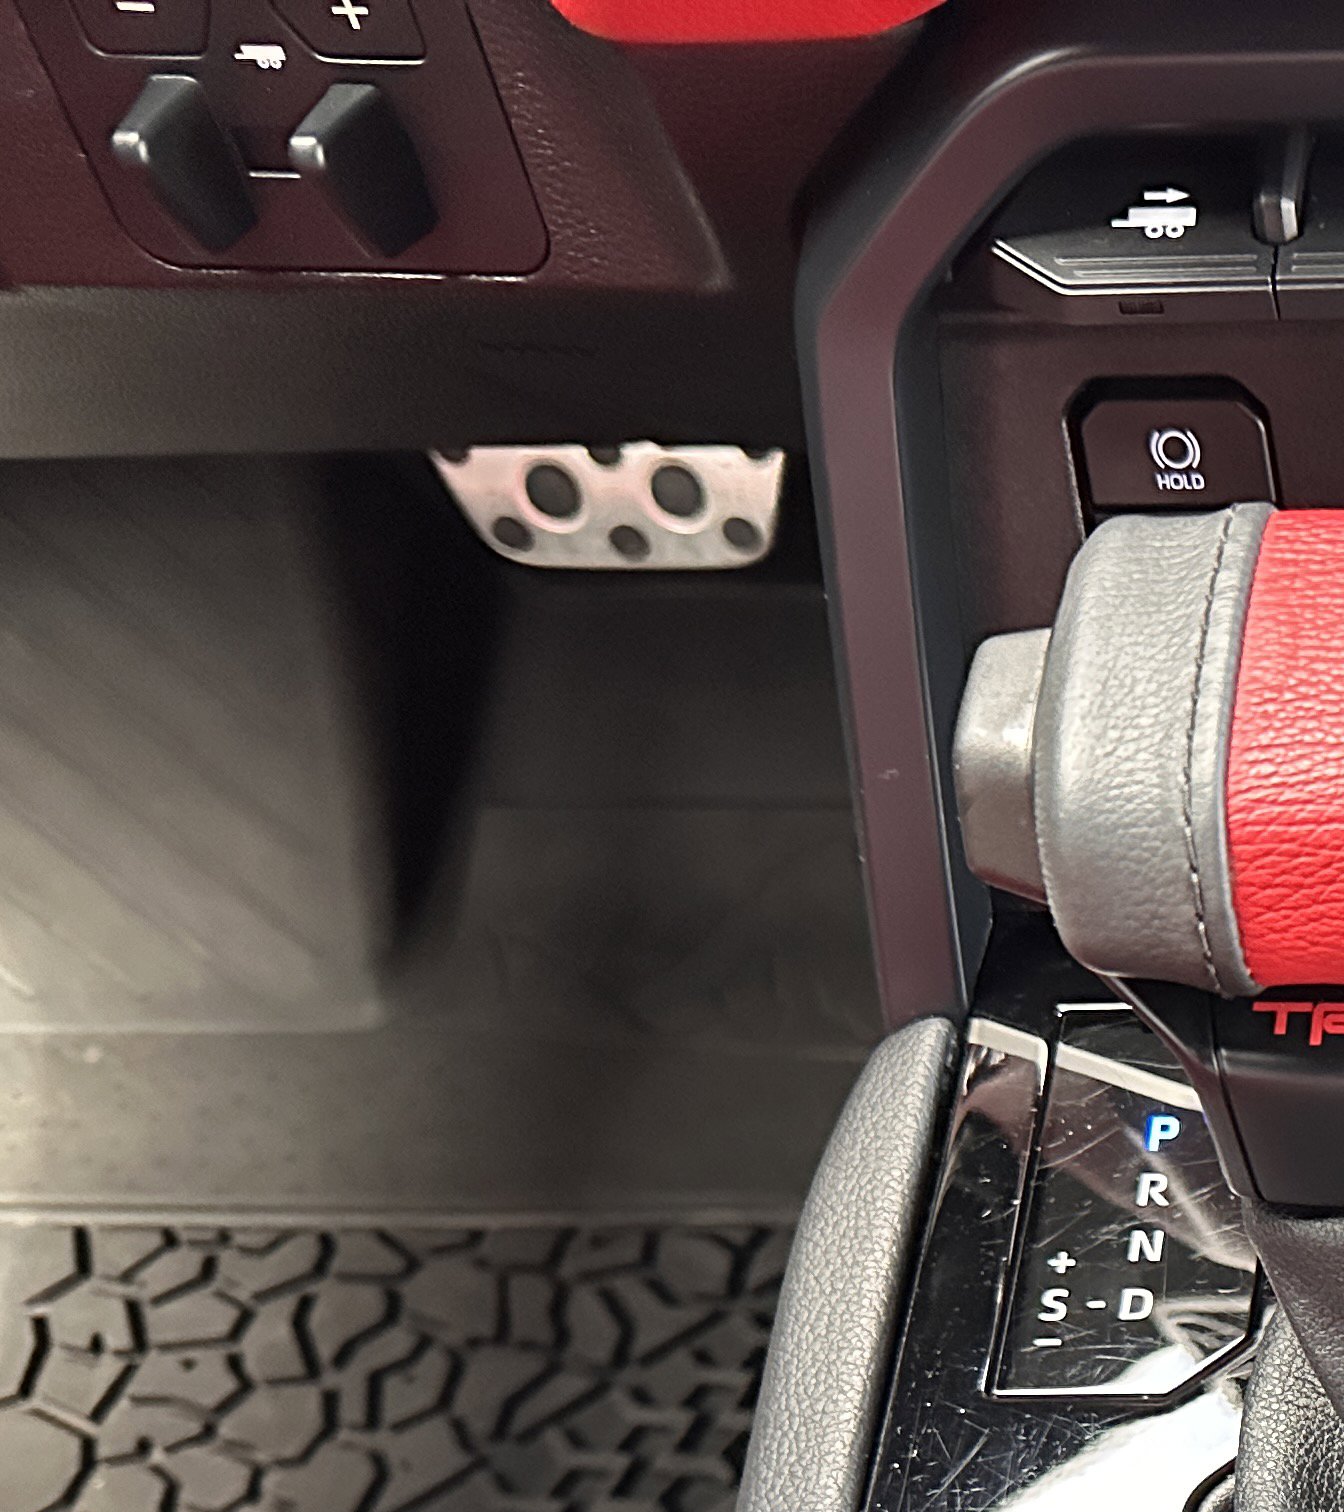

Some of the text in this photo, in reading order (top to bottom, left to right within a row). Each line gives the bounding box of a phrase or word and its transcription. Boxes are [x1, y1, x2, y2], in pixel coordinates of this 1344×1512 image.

[1156, 473, 1205, 490] HOLD
[1144, 1114, 1181, 1154] P
[1136, 1173, 1170, 1207] R
[1127, 1229, 1165, 1262] N
[1037, 1288, 1156, 1322] S D
